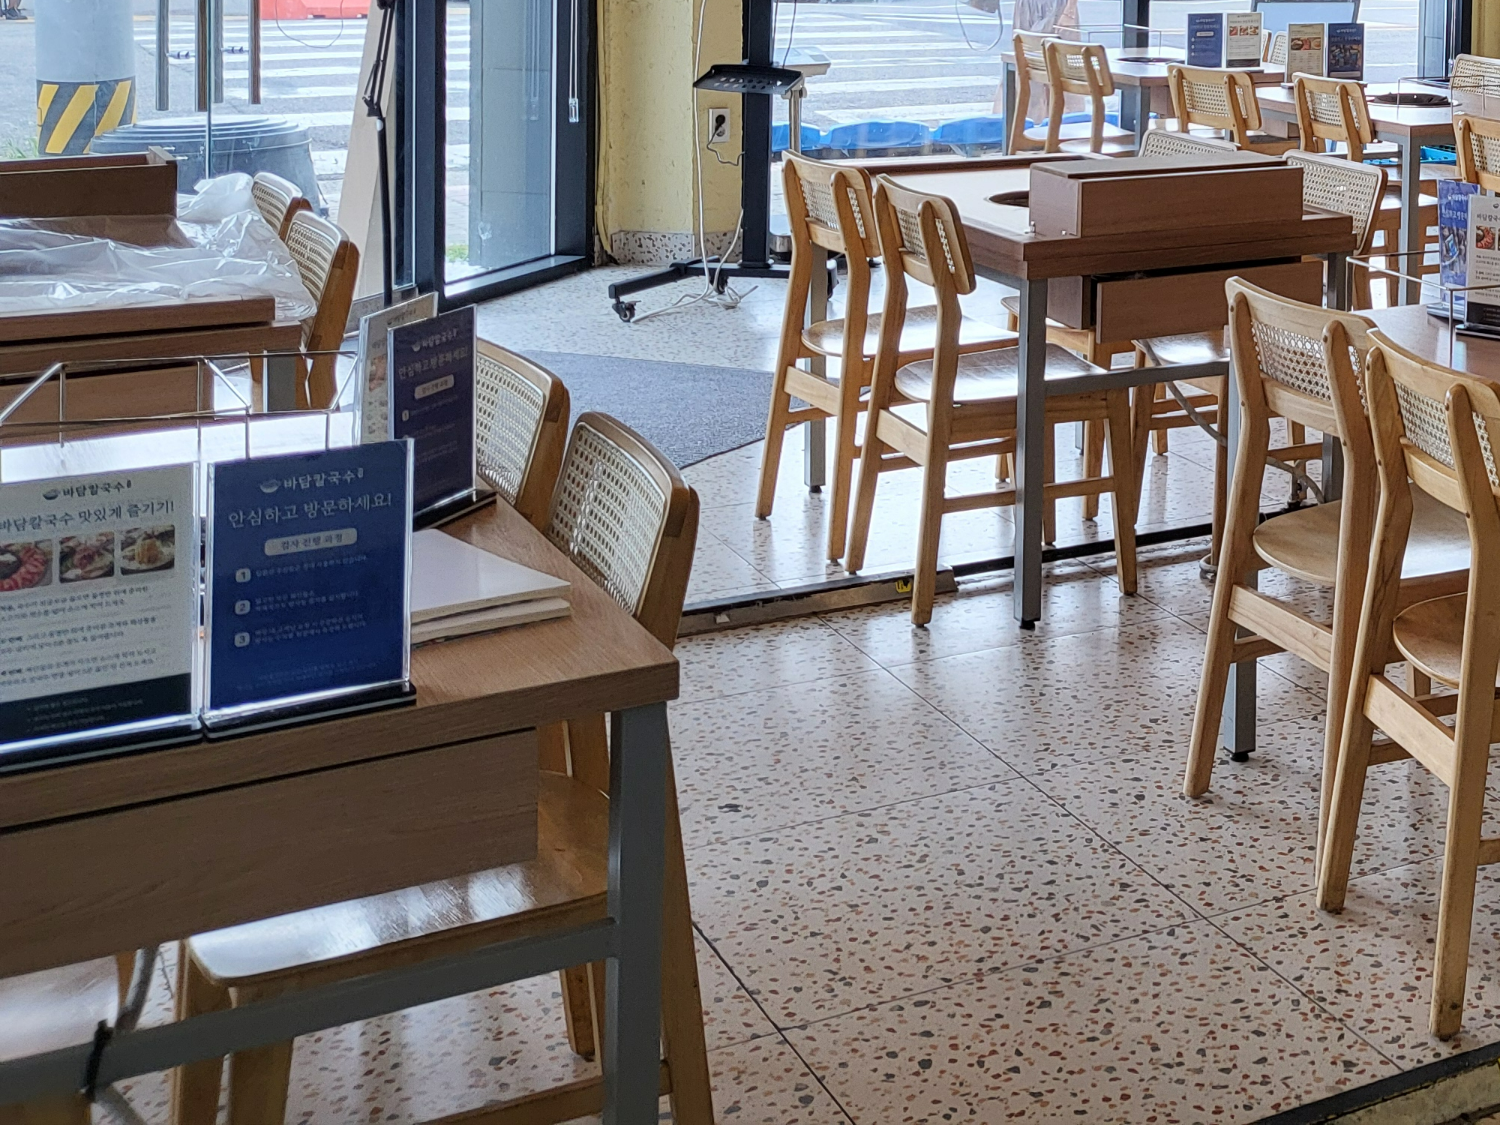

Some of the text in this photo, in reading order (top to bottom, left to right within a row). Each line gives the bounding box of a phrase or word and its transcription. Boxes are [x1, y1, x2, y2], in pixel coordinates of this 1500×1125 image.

[62, 481, 125, 499] 바담칼국수
[284, 470, 355, 491] 바담칼국수
[0, 500, 175, 533] 바담칼국수 맛있게 즐기기!
[228, 493, 392, 529] 안심하고 방문하세요!
[281, 537, 299, 551] 검사
